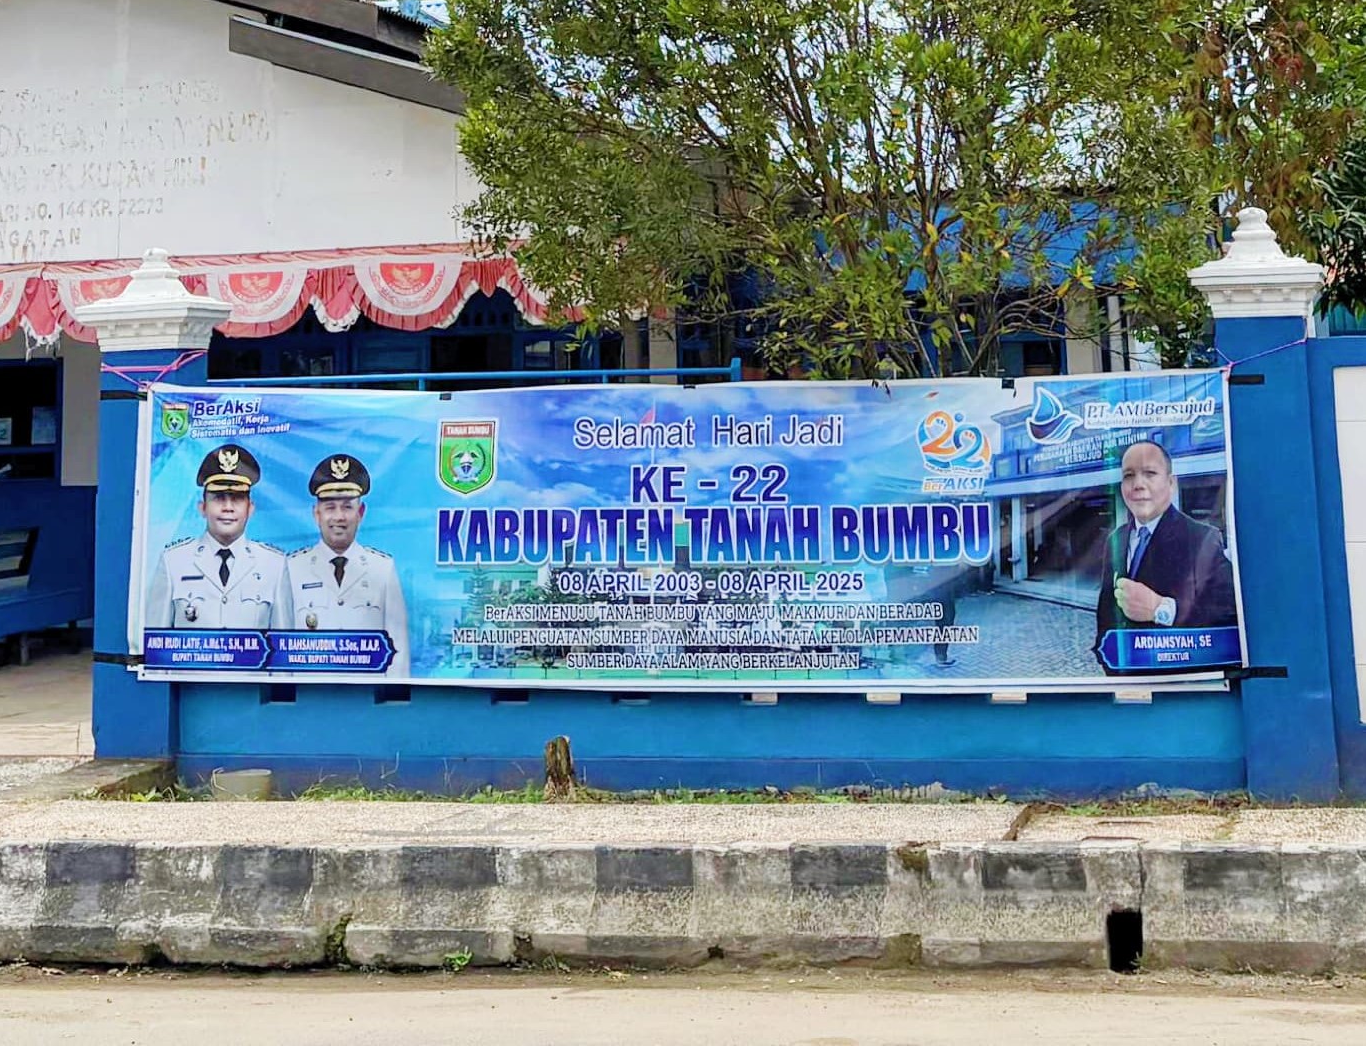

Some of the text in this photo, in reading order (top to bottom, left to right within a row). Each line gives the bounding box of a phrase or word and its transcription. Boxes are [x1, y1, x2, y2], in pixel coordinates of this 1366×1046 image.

[194, 398, 260, 417] BerAksi
[1144, 399, 1213, 418] Bersujud
[574, 415, 843, 446] Selamat Hari Jadi
[633, 466, 686, 503] KE
[731, 465, 788, 502] 22
[436, 505, 992, 564] KABUPATEN TANAH BUMBU
[560, 573, 584, 592] 08
[588, 573, 649, 592] APRIL
[654, 573, 701, 592] 2003
[720, 573, 744, 592] 08
[749, 573, 811, 592] APRIL
[816, 573, 864, 591] 2025
[486, 605, 536, 621] BerAKSI
[538, 605, 595, 621] MENUJU
[600, 605, 645, 621] TANAH
[647, 605, 695, 621] BUMBU
[699, 605, 734, 620] YANG
[782, 605, 844, 620] MAKMUR
[847, 604, 877, 620] DAN
[879, 604, 943, 619] BERADAB
[453, 627, 979, 644] MELALUI PENGUATAN SUMBER DAYA MANUSIA DAN TATA KELOLA PEMANFAATAN
[1134, 634, 1212, 650] ARDIANSYAH, SE
[567, 653, 859, 670] SUMBER DAYA ALAM YANG BERKELANJUTAN
[1156, 651, 1190, 662] DIREKTUR
